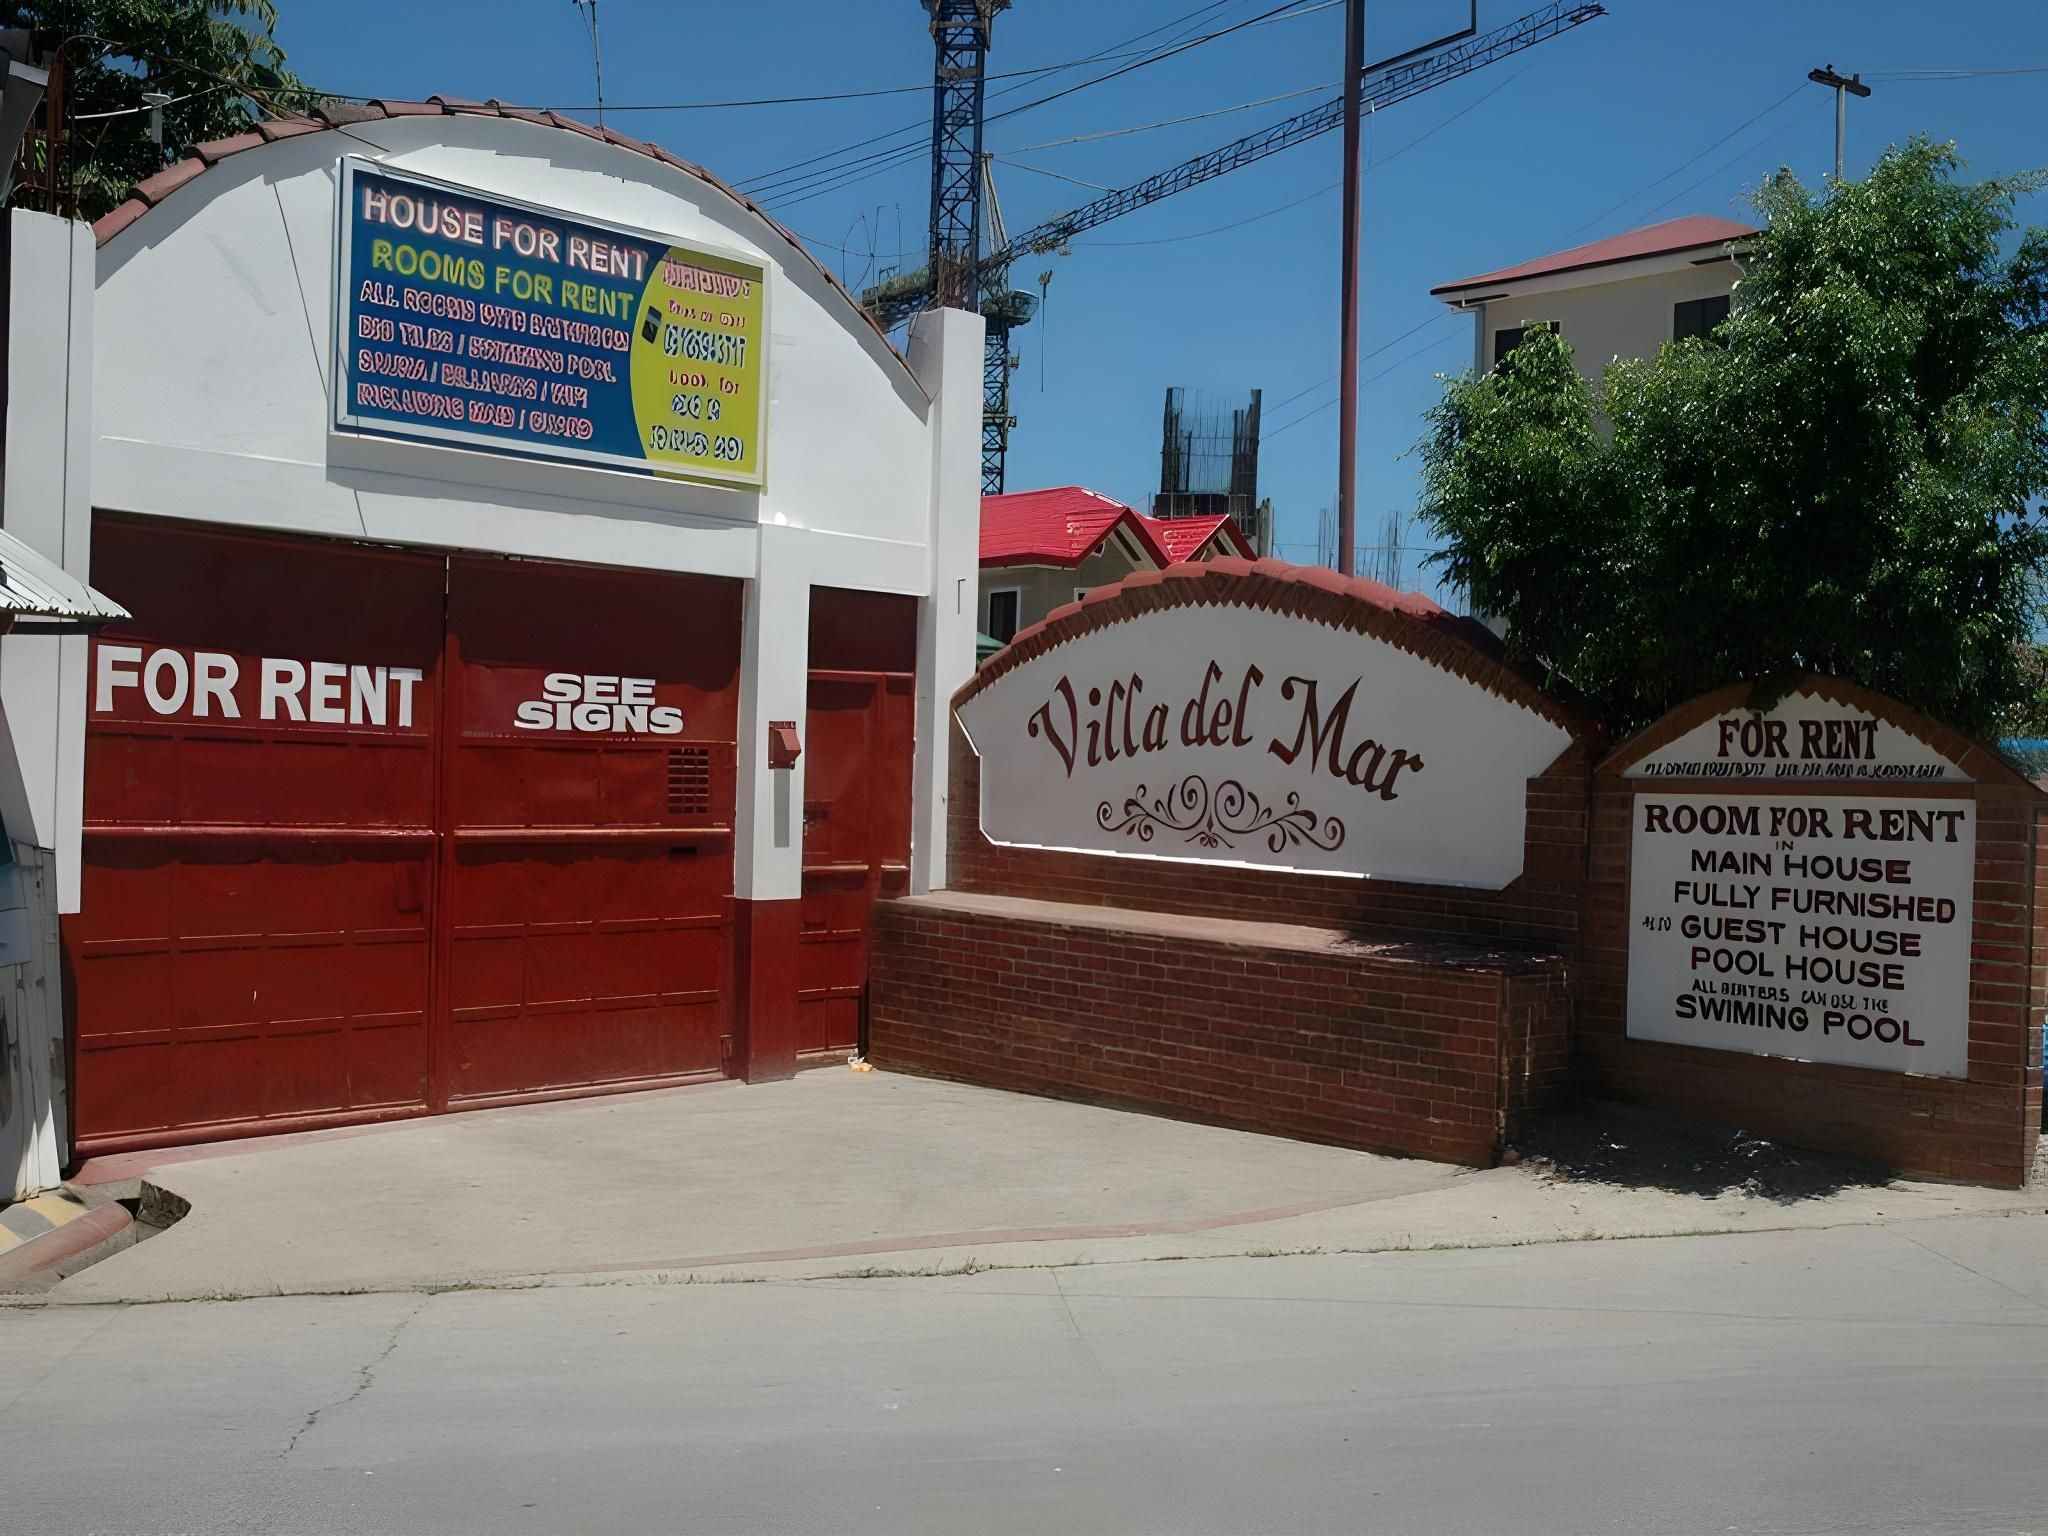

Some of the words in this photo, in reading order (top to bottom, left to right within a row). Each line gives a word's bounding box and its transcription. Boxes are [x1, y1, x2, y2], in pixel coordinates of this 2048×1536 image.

[362, 186, 484, 245] HOUSE
[492, 217, 559, 264] FOR
[568, 236, 648, 281] RENT
[372, 239, 485, 290] ROOMS
[495, 267, 553, 305] FOR
[561, 280, 633, 320] RENT
[95, 644, 241, 718] FOR
[260, 658, 423, 727] RENT
[542, 673, 656, 705] SEE
[514, 702, 683, 734] SIGNS
[1027, 671, 1169, 779] Villa
[1180, 659, 1264, 748] del
[1267, 675, 1424, 801] Mar
[1718, 719, 1789, 758] FOR
[1800, 720, 1878, 759] RENT
[1645, 804, 1760, 835] ROOM
[1770, 807, 1833, 838] FOR
[1843, 809, 1965, 843] RENT
[1776, 840, 1794, 851] IN
[1691, 850, 1772, 876] MAIN
[1784, 855, 1911, 884] HOUSE
[1674, 881, 1761, 909] FULLY
[1772, 888, 1956, 924] FURNISHED
[1680, 915, 1786, 945] GUEST
[1800, 925, 1921, 957] HOUSE
[1691, 946, 1774, 977] POOL
[1786, 955, 1905, 990] HOUSE
[1675, 993, 1808, 1032] SWIMING
[1824, 1011, 1925, 1047] POOL
